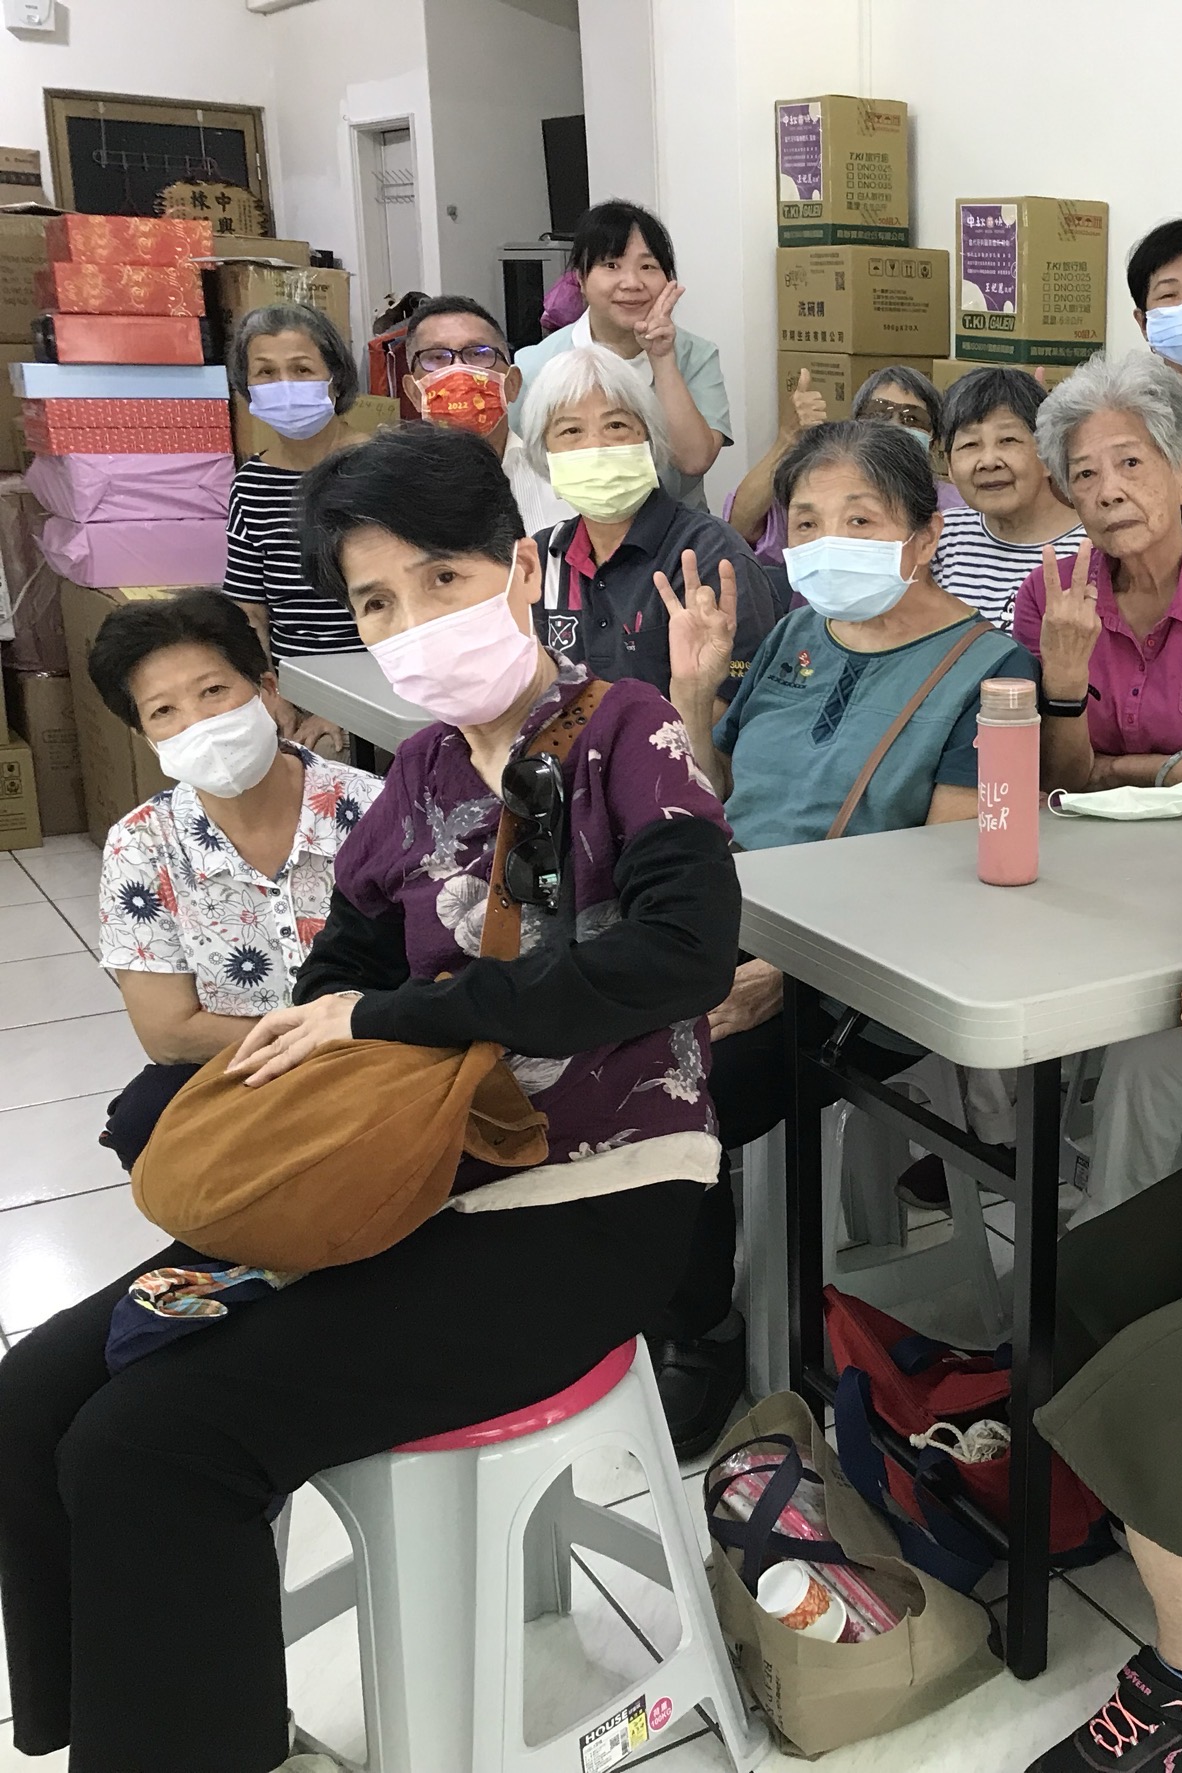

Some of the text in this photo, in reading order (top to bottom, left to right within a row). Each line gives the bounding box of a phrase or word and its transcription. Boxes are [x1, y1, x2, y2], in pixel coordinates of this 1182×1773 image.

[783, 205, 799, 218] T.KI
[1046, 261, 1088, 273] T.KI 旅行組
[1053, 273, 1091, 282] DNO:025
[1053, 283, 1092, 293] DNO:032
[1053, 294, 1092, 303] DNO:035
[798, 301, 825, 317] 洗碗精
[964, 316, 984, 329] T.KI
[448, 401, 469, 410] 2022
[650, 1706, 672, 1727] 100KG
[585, 1708, 628, 1745] HOUSE
